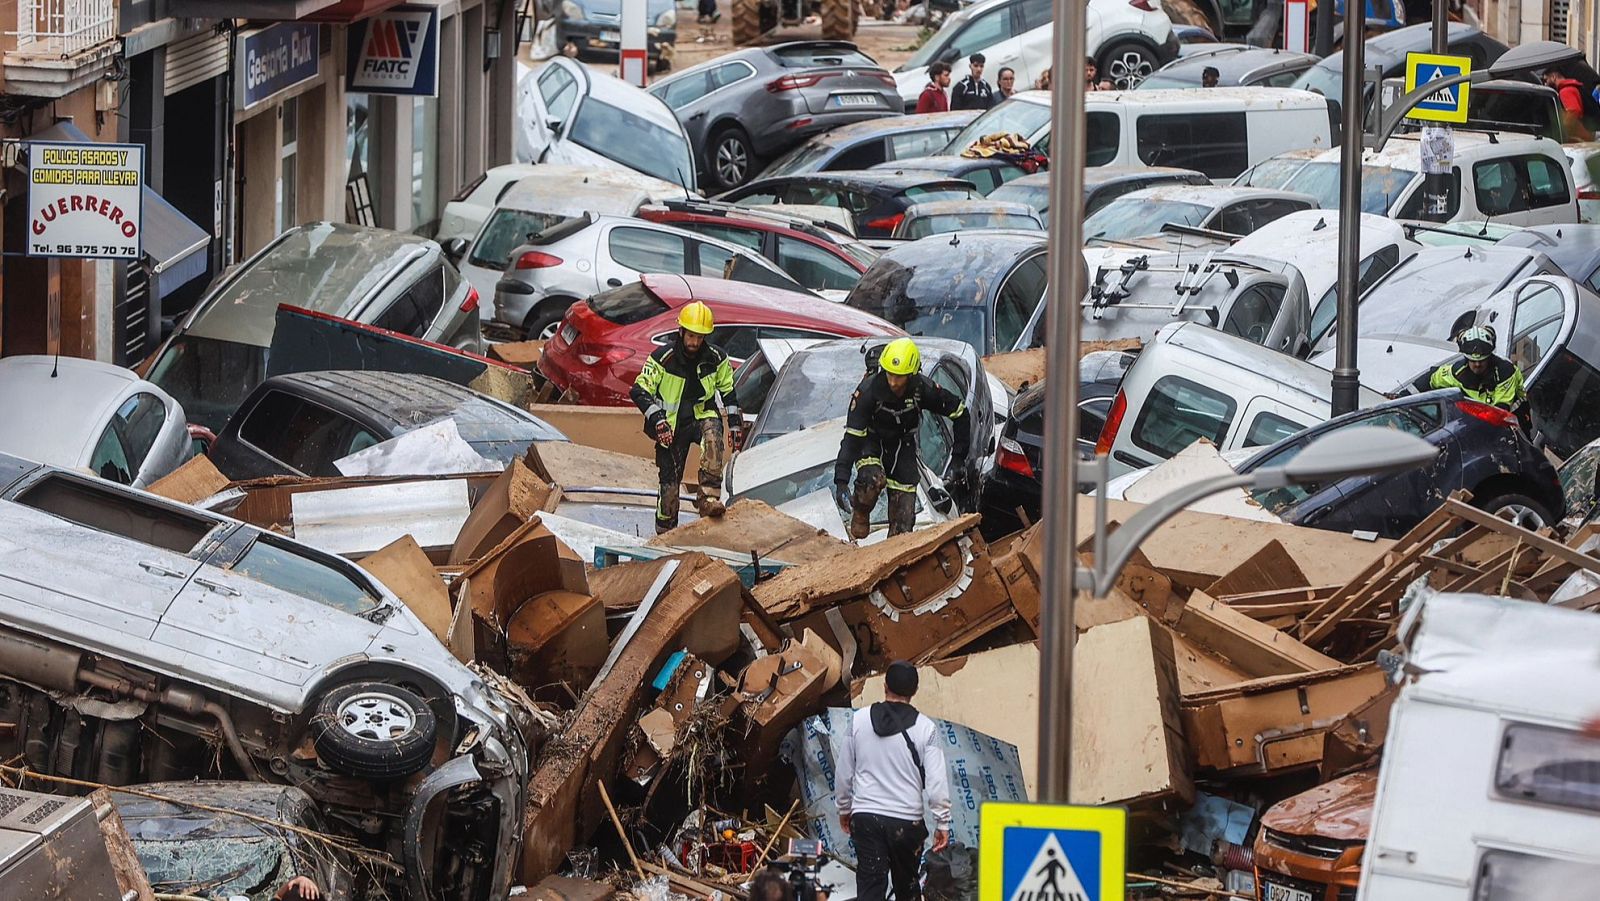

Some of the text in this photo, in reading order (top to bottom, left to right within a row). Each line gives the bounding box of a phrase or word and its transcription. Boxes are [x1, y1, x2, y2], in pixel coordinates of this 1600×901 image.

[363, 60, 410, 74] FIATC
[43, 149, 128, 167] POLLOS ASADOS Y
[33, 168, 138, 186] COMIDAS PARA LLEVAR
[32, 195, 136, 238] GUERRERO
[33, 244, 136, 255] Tel. 96 375 70 76
